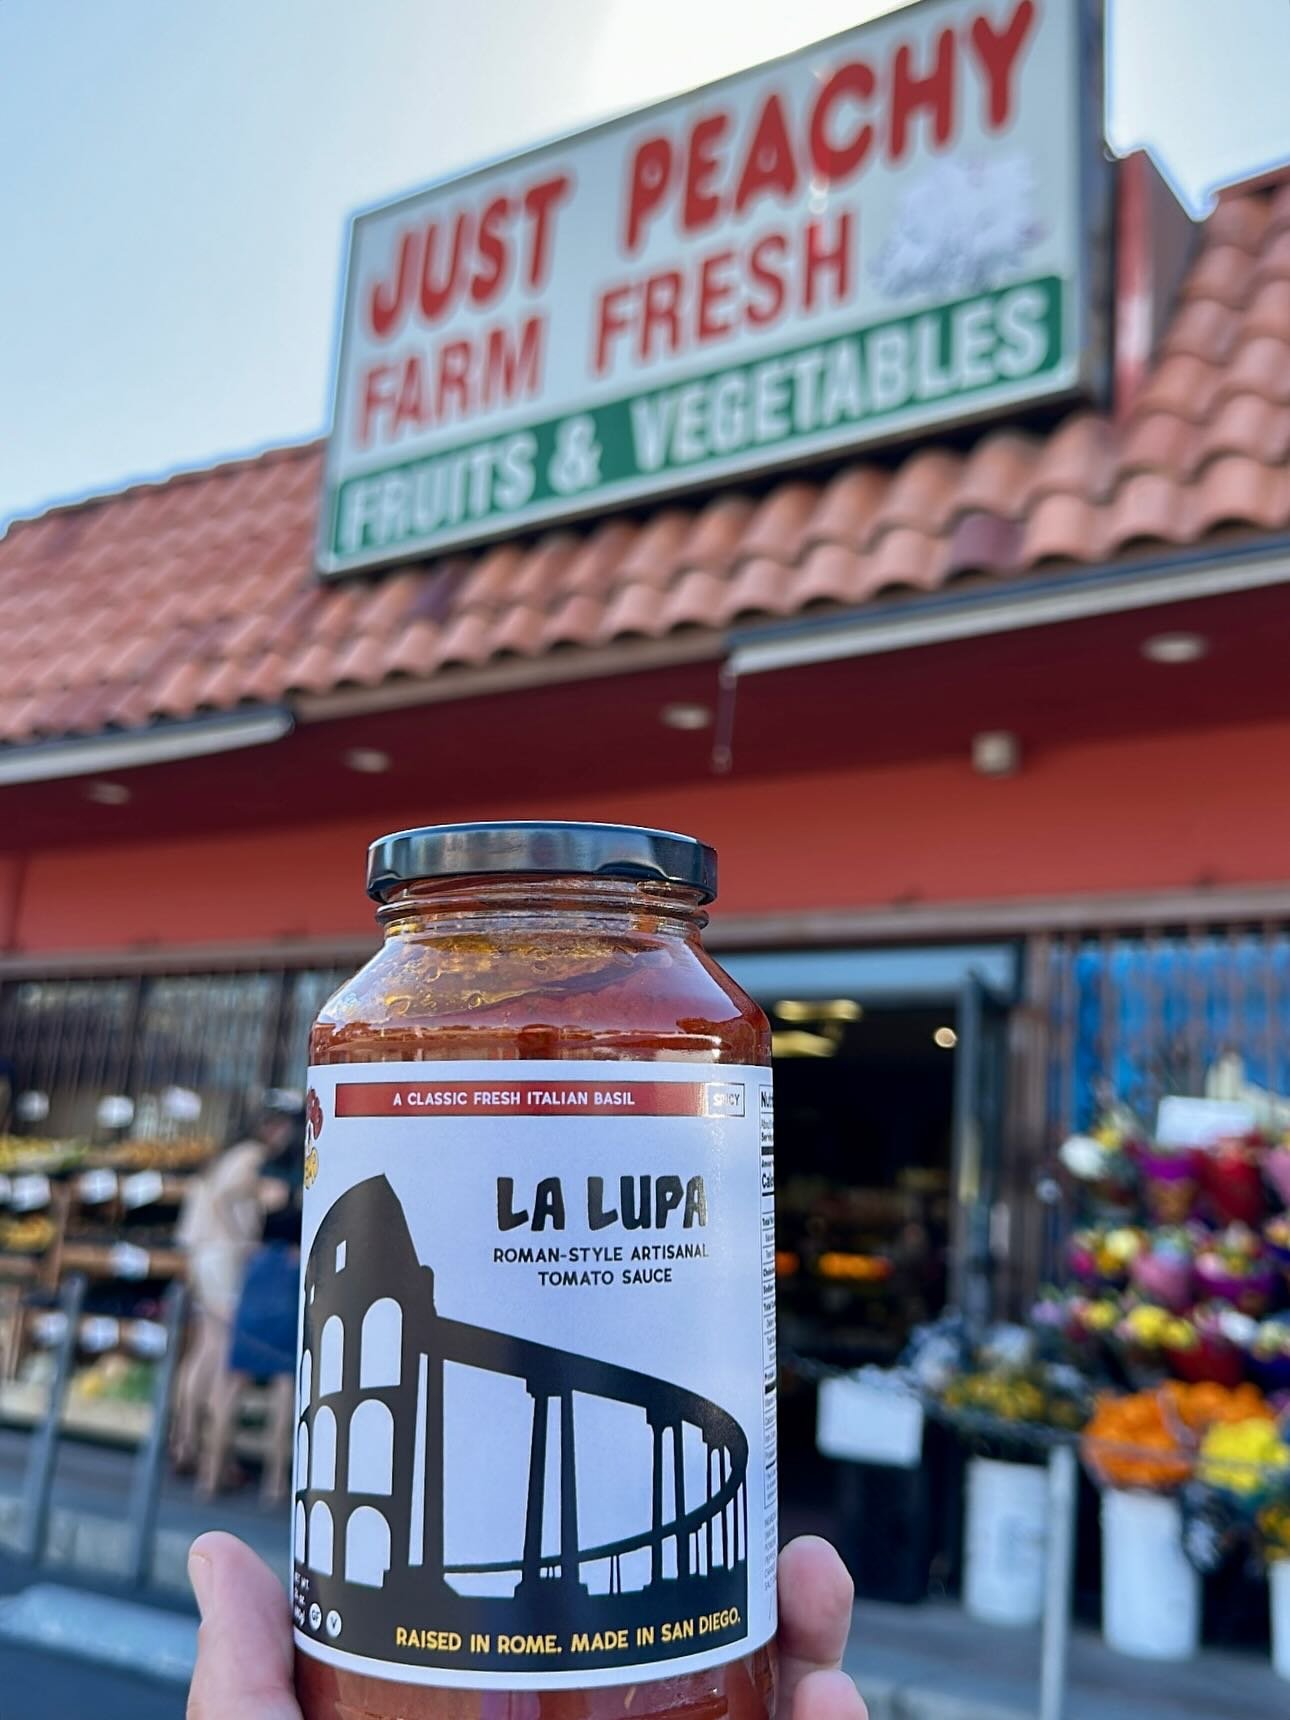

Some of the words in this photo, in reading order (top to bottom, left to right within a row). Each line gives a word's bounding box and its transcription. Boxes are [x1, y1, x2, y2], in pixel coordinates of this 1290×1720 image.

[369, 174, 570, 338] JUST
[623, 0, 1034, 253] PEACHY
[356, 316, 544, 450] FARM
[592, 212, 854, 375] FRESH
[340, 429, 537, 551] FRUITS
[549, 411, 600, 491] &
[630, 286, 1048, 471] VEGETABLES
[393, 1092, 403, 1106] A
[407, 1091, 468, 1106] CLASSIC
[474, 1091, 521, 1105] FRESH
[527, 1090, 588, 1106] ITALIAN
[594, 1091, 635, 1106] BASIL
[496, 1176, 565, 1232] LA
[587, 1174, 709, 1231] LUPA
[493, 1246, 623, 1263] ROMAN-STYLE
[631, 1243, 709, 1261] ARTISANAL
[538, 1271, 614, 1286] TOMATO
[622, 1268, 672, 1284] SAUCE
[396, 1626, 462, 1652] RAISED
[470, 1635, 490, 1654] IN
[497, 1635, 562, 1654] ROME.
[571, 1630, 629, 1652] MADE
[636, 1626, 654, 1647] IN
[661, 1620, 694, 1644] SAN
[698, 1606, 741, 1635] DIEGO.
